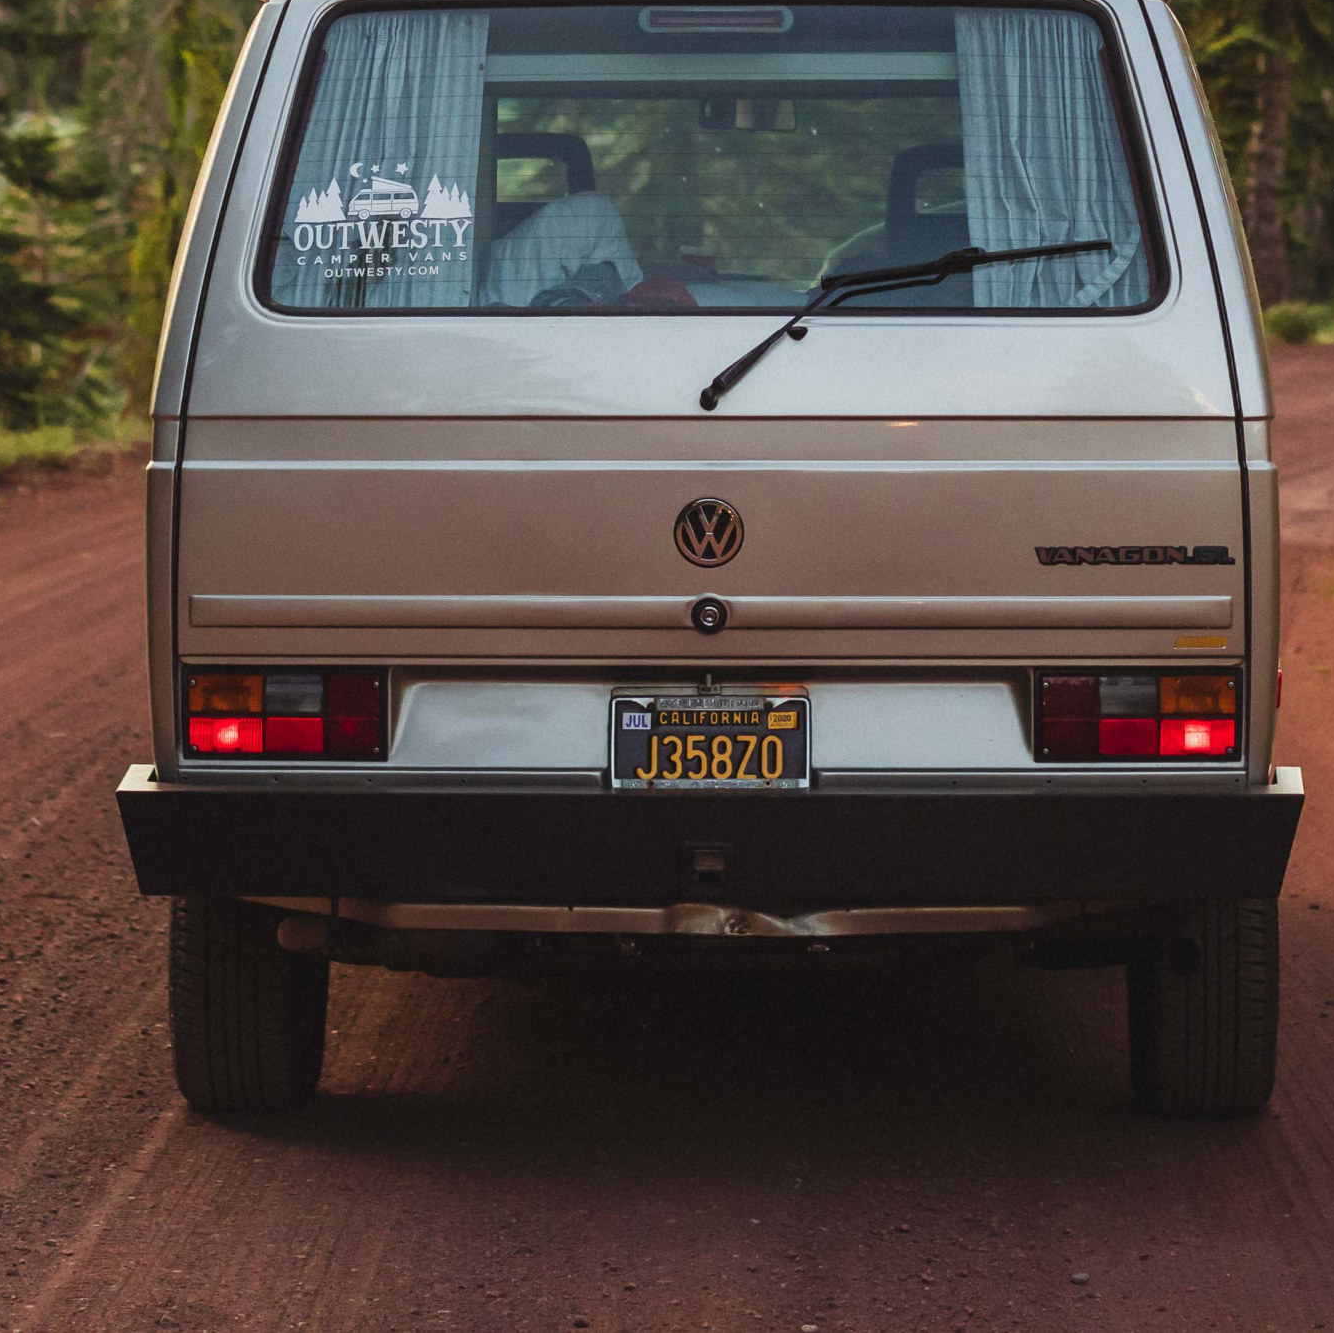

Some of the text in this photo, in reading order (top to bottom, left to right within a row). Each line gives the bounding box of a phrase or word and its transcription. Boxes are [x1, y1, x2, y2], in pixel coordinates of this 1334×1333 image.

[294, 219, 472, 251] OUTWESTY
[297, 251, 468, 265] CAMPER VANS
[324, 266, 440, 278] OUTWESTY.COM
[1034, 545, 1188, 565] VANAGON
[625, 714, 649, 728] JUL
[659, 711, 760, 725] CALIFORNIA
[772, 714, 792, 723] 2020
